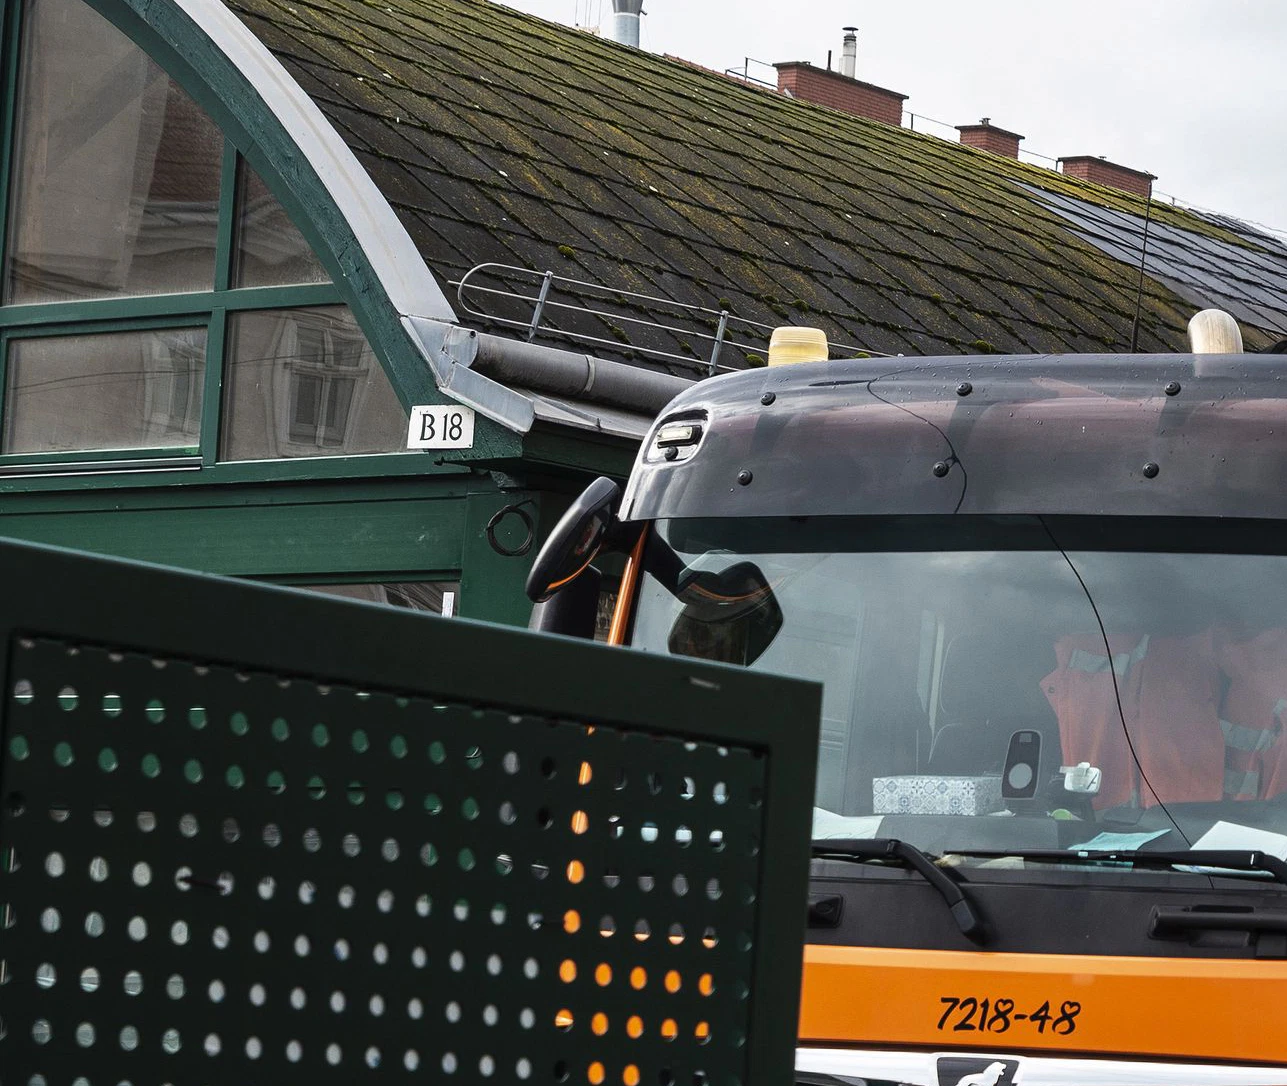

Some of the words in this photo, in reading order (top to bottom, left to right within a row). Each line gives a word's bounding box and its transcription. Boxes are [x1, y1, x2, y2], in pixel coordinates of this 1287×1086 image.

[420, 413, 436, 440] B
[442, 412, 462, 441] 18
[937, 997, 1081, 1035] 7218-48
